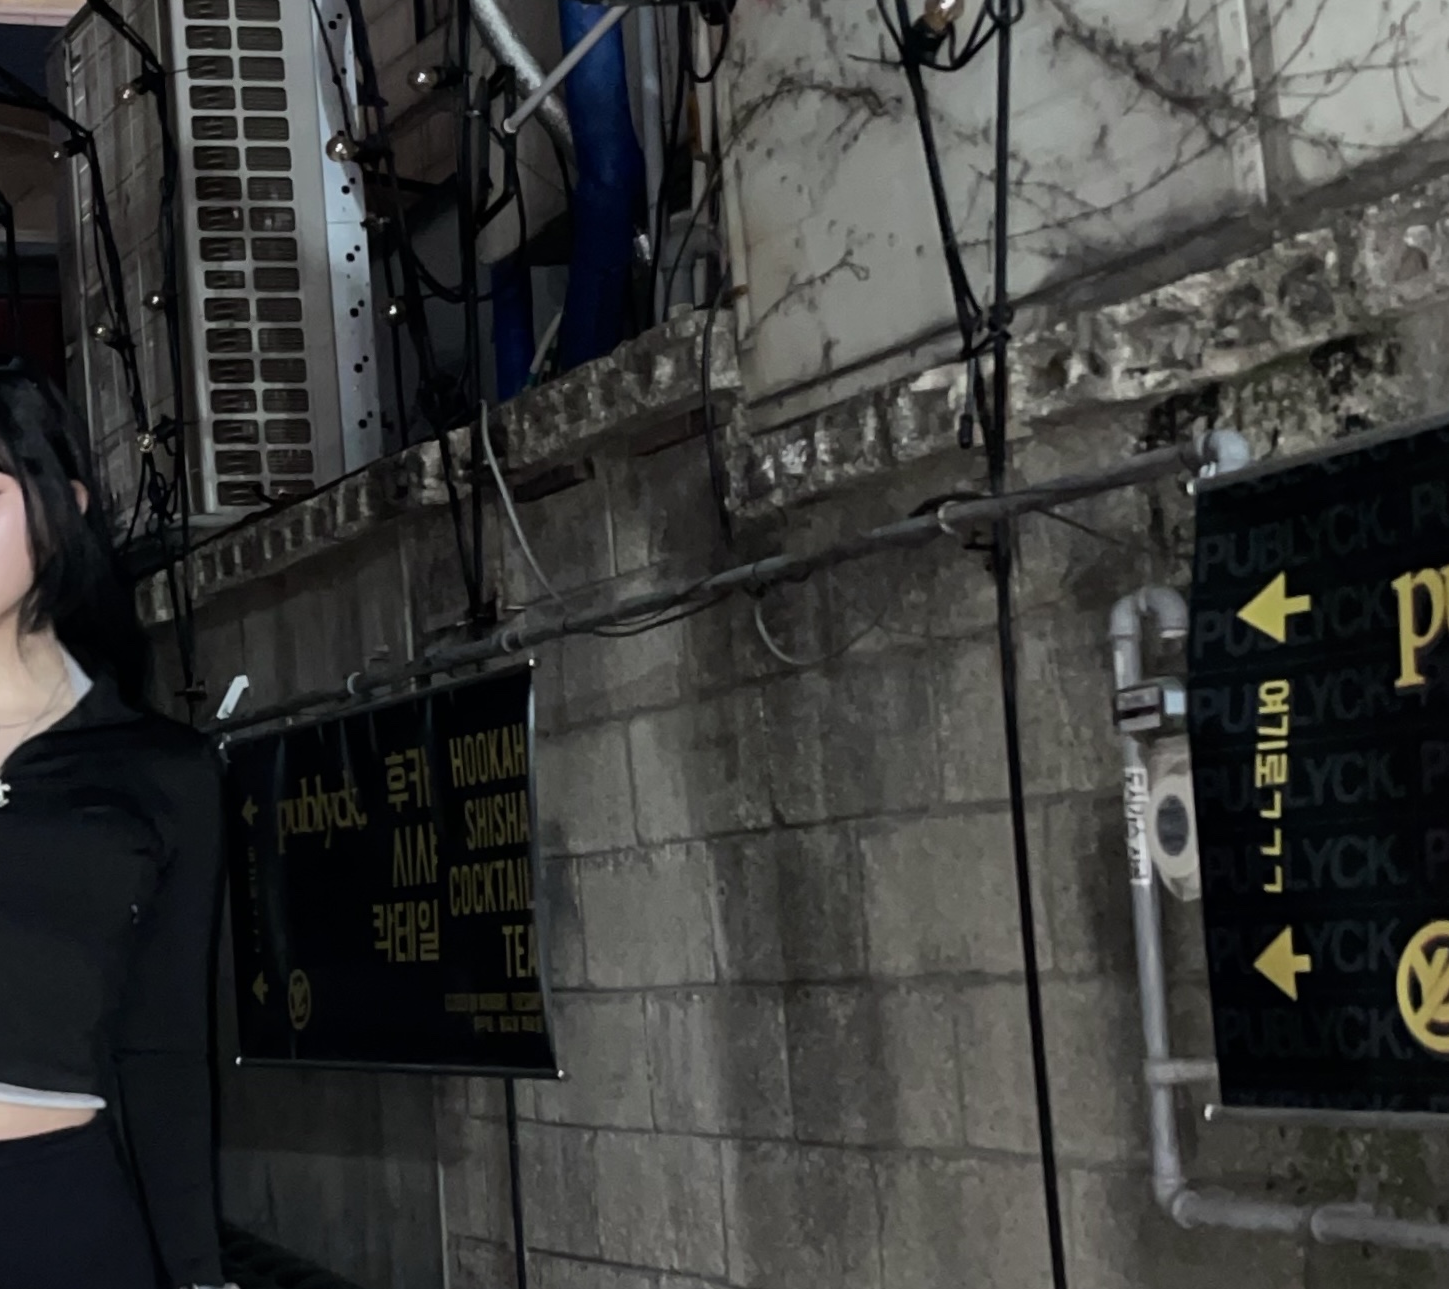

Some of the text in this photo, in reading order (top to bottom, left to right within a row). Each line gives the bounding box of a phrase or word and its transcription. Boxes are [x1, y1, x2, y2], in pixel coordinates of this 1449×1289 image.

[383, 744, 434, 814] 후카
[448, 721, 528, 789] HOOKAH
[463, 789, 530, 852] SHISHA
[371, 899, 441, 964] 칵테일
